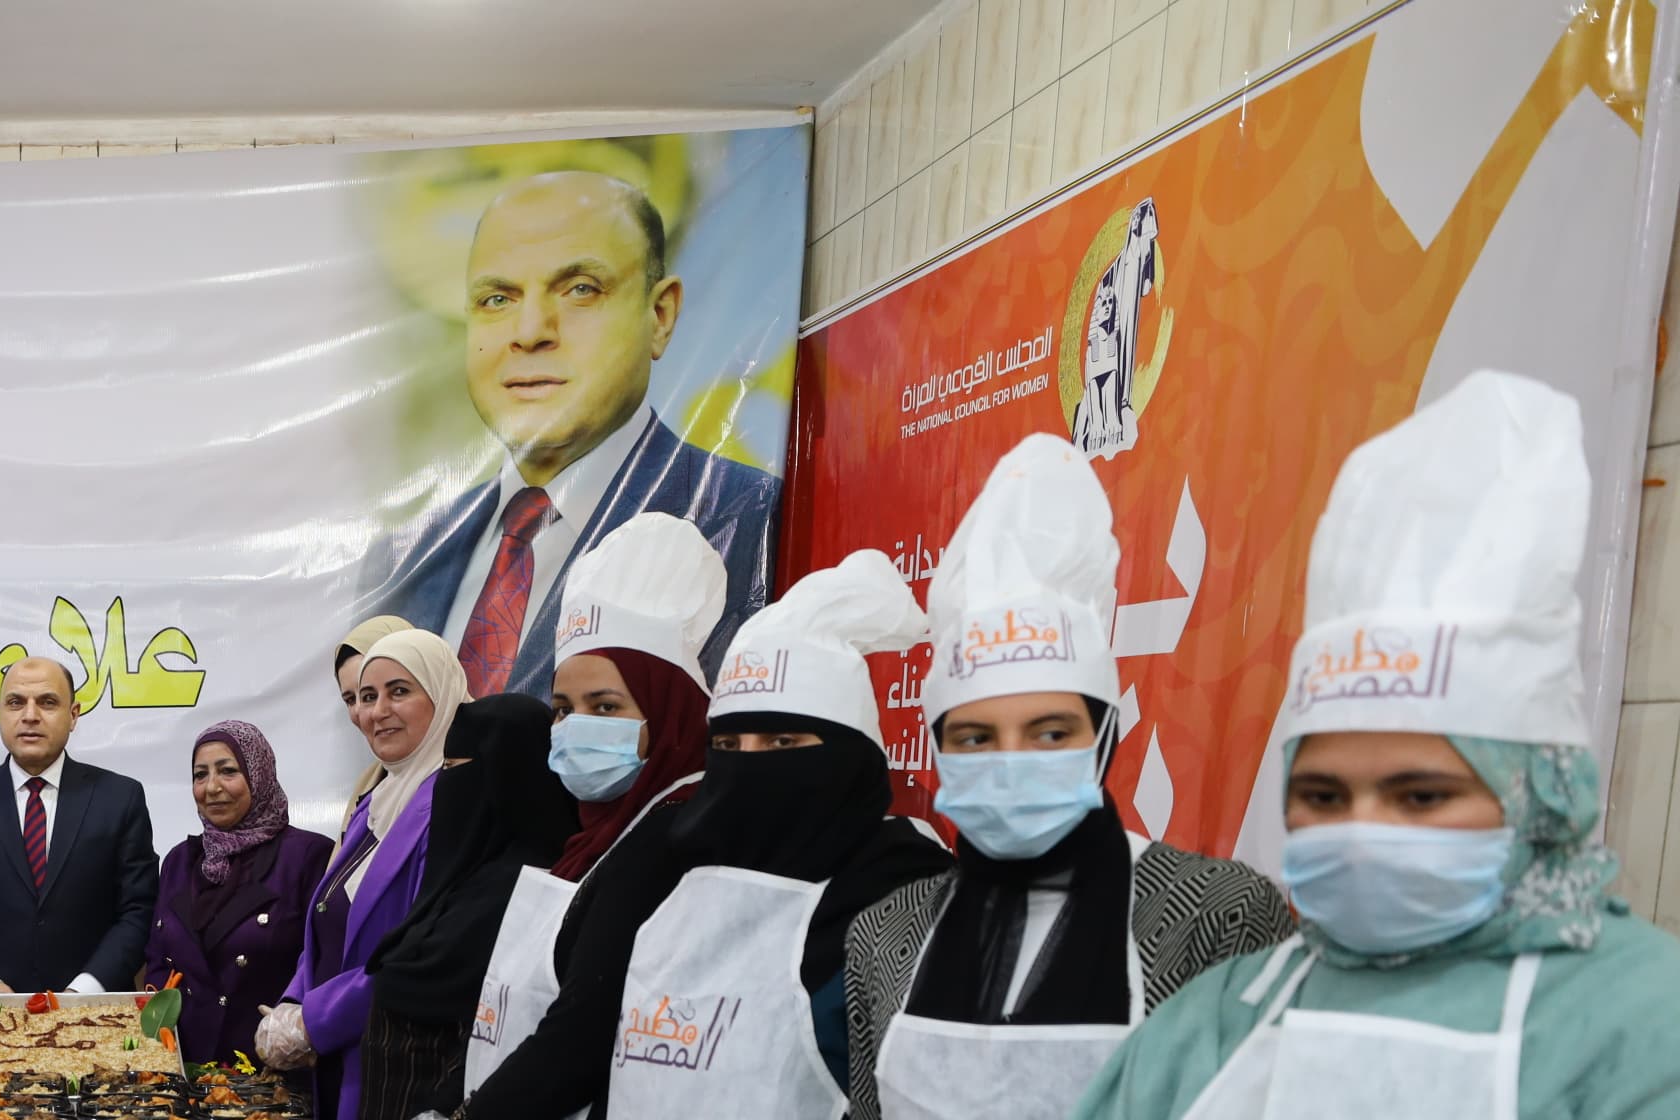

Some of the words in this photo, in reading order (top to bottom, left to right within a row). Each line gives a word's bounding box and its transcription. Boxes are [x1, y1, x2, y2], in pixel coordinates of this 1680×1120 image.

[938, 351, 993, 402] القومي
[996, 326, 1053, 376] المجلس
[901, 422, 917, 440] THE
[917, 410, 953, 434] NATIONAL
[954, 395, 991, 420] COUNCIL
[992, 388, 1010, 408] FOR
[1011, 373, 1049, 399] WOMEN
[964, 608, 1058, 662] مطبخ
[1307, 625, 1422, 695] مطبخ
[614, 996, 742, 1071] المصر
